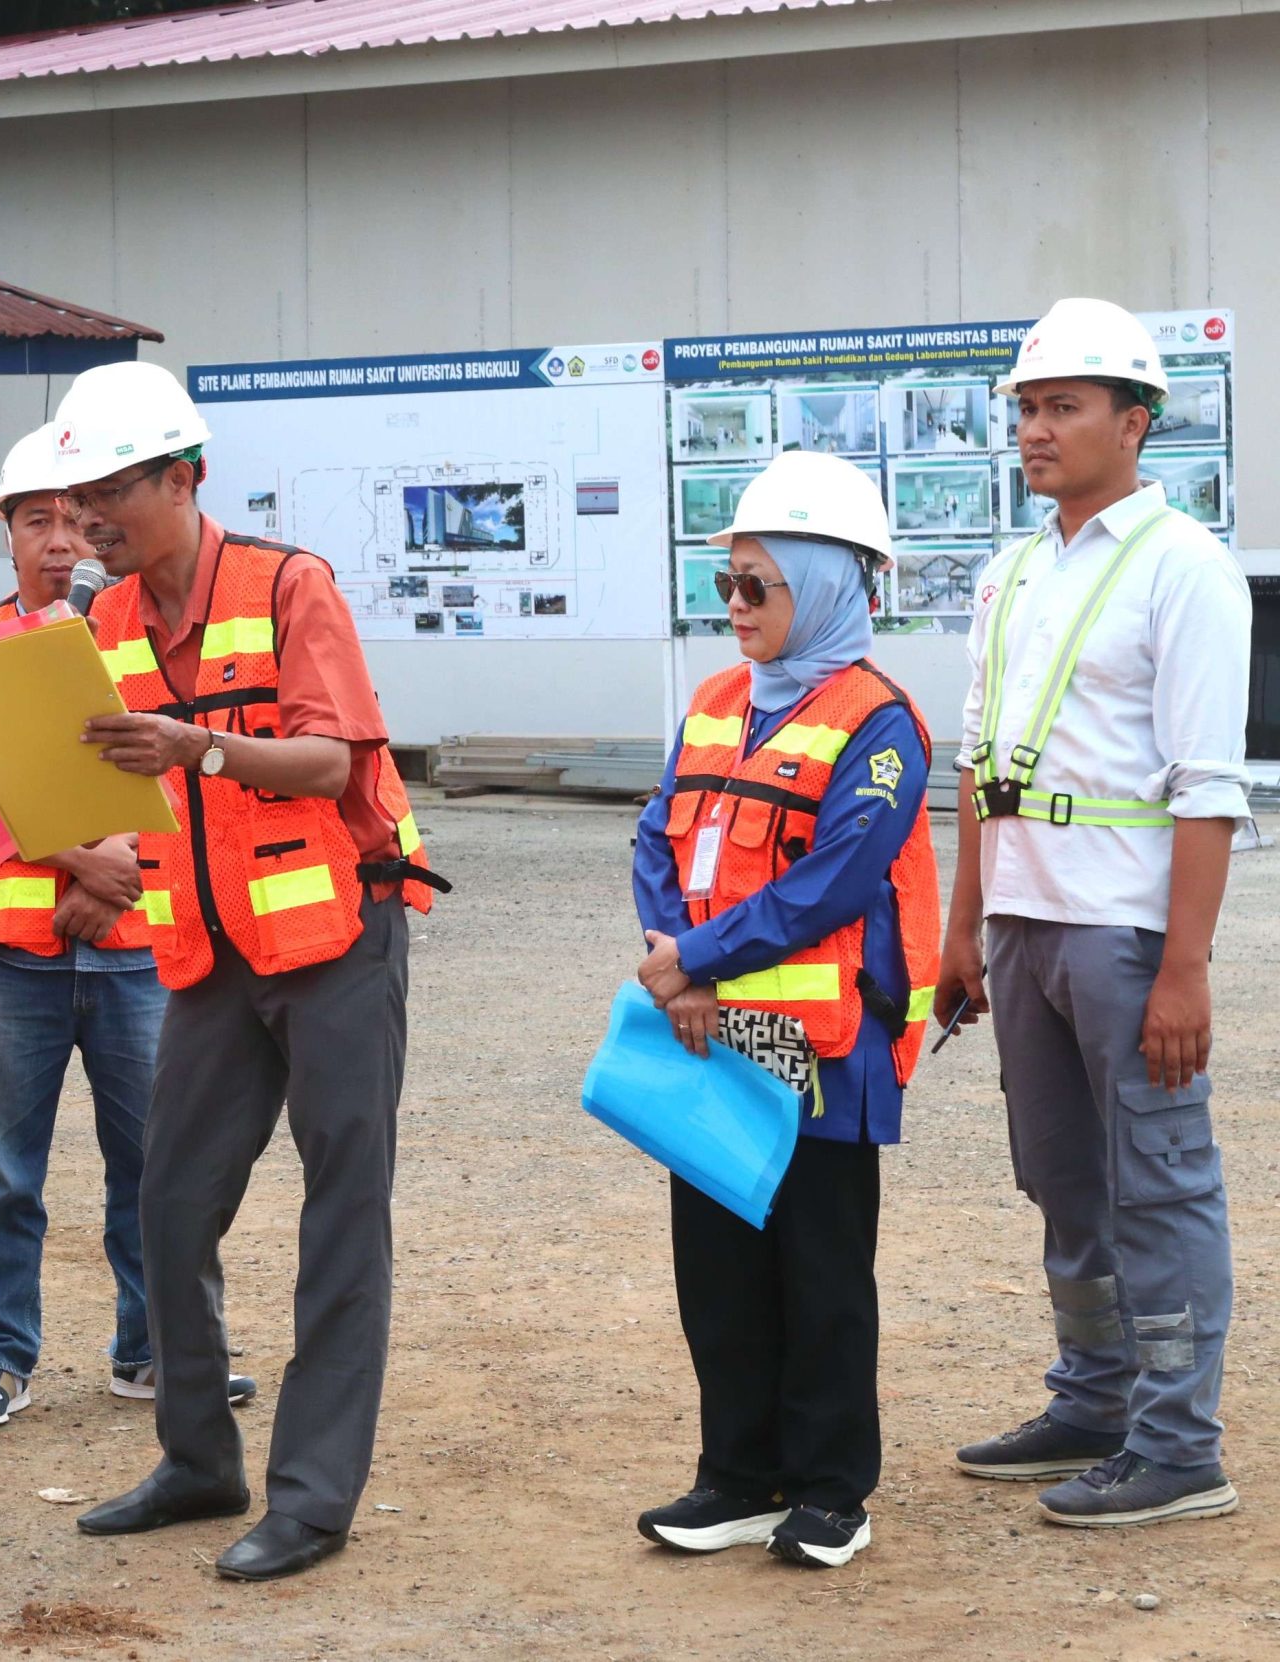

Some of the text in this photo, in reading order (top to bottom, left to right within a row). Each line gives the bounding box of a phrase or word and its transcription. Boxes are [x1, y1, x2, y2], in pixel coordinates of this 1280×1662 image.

[1160, 325, 1177, 335] SFD
[674, 327, 1029, 359] PROYEK PEMBANGUNAN RUMAH SAKIT UNIVERSITAS BENG
[604, 356, 619, 365] SFD
[719, 346, 1013, 371] (Pembangunan Rumah Sakit Pendidikan dan Gedung Laboratorium Penelitian)
[198, 360, 520, 392] SITE PLANE PEMBANGUNAN RUMAH SAKIT UNIVERSITAS BENGKULU
